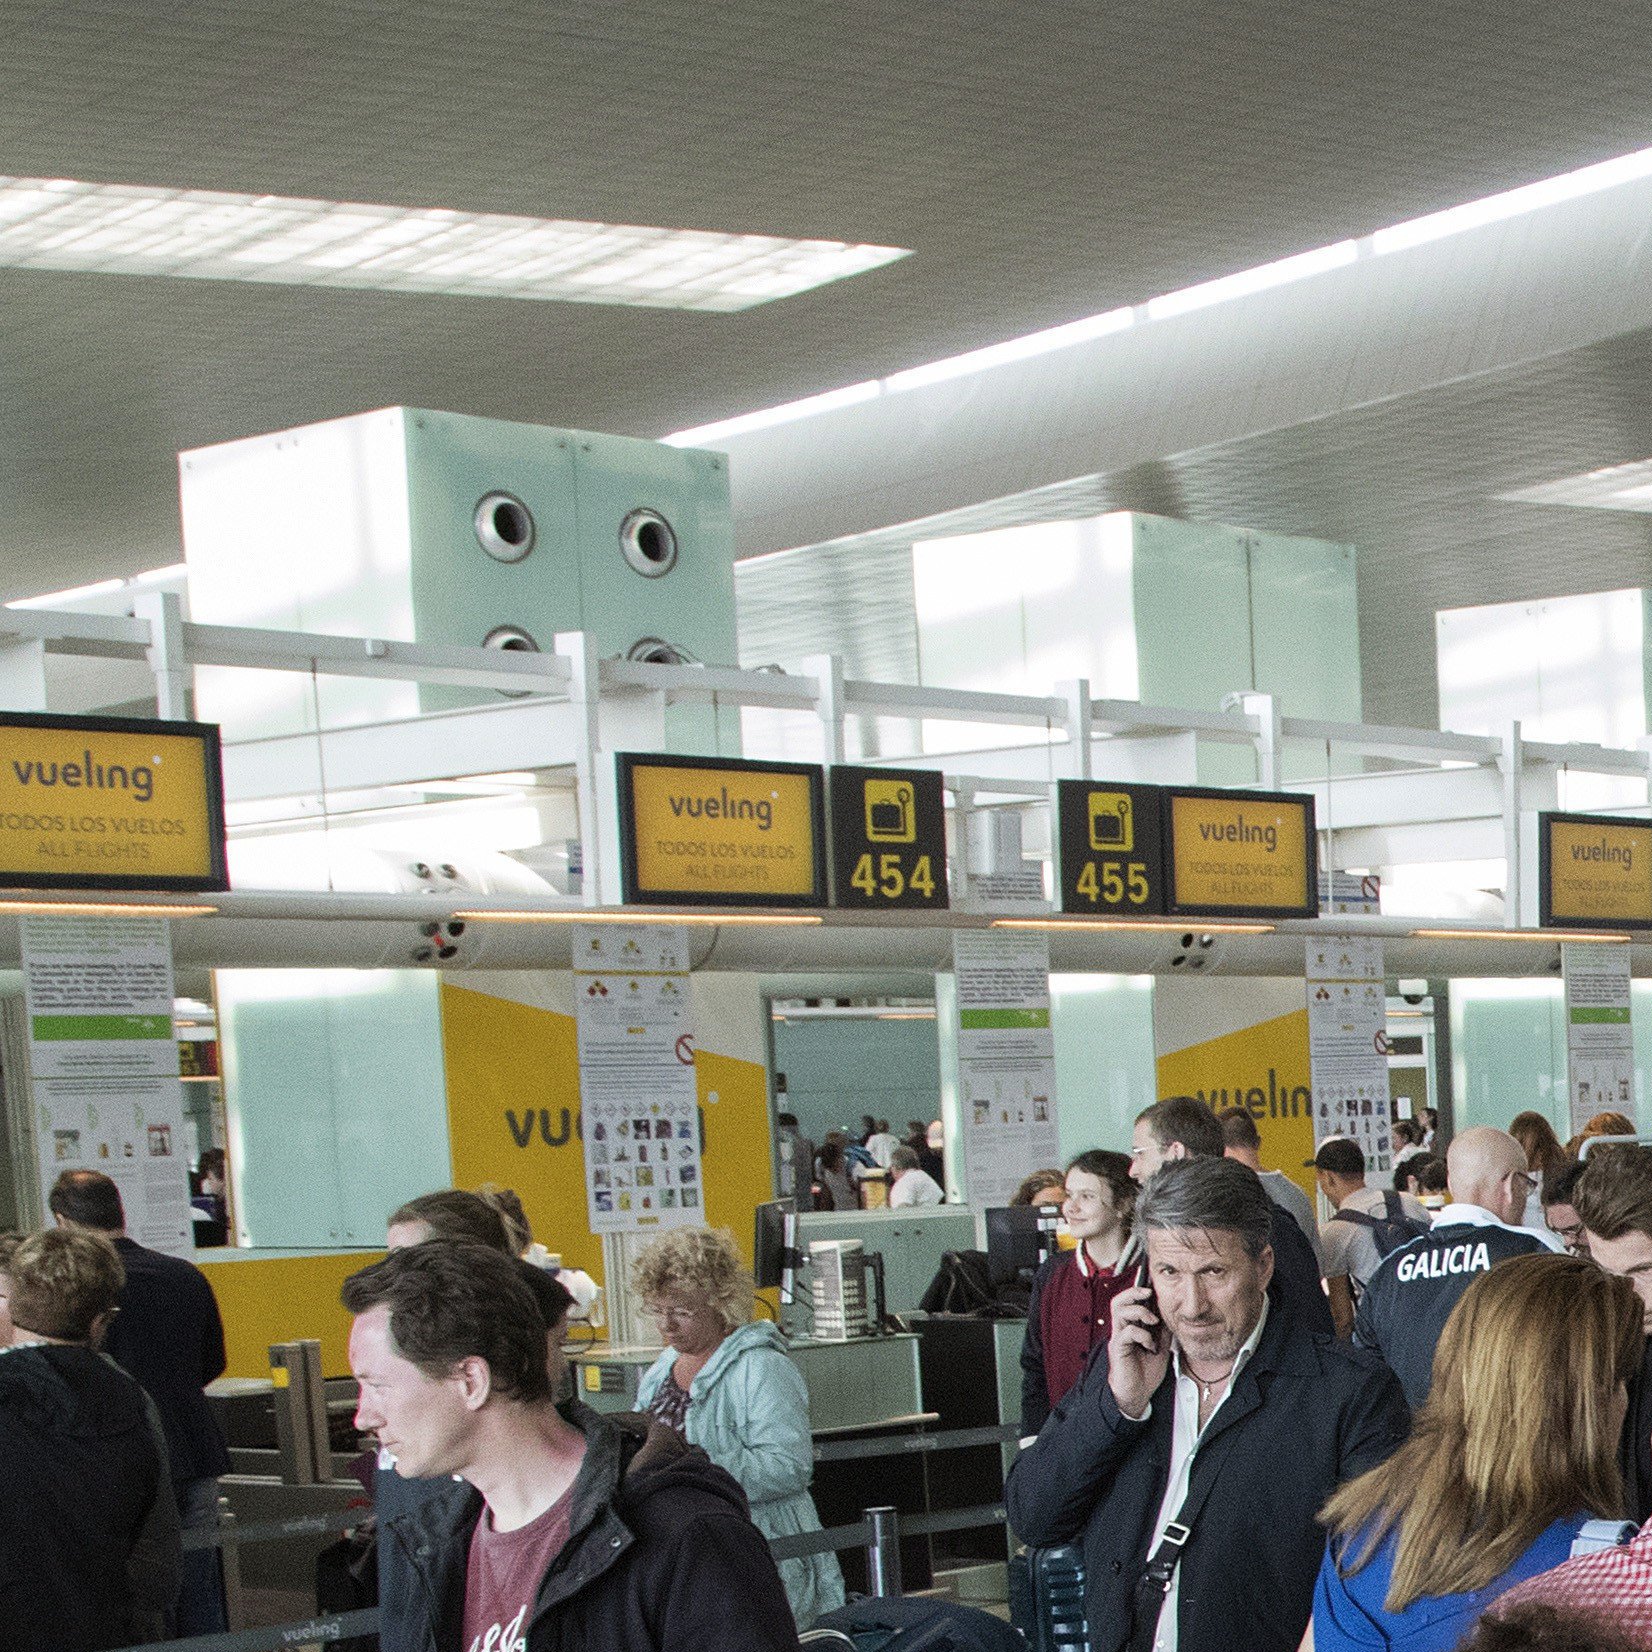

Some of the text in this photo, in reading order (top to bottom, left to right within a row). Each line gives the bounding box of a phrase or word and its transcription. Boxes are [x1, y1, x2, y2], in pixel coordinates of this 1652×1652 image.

[12, 749, 154, 803] vueling
[70, 815, 107, 834] LOS
[110, 817, 186, 836] VUELOS
[668, 786, 773, 832] vueling
[657, 840, 706, 858] TODOS
[1199, 814, 1278, 853] vueling
[1571, 838, 1632, 871] vueling
[851, 853, 935, 899] 454
[1076, 861, 1150, 905] 455
[1396, 1242, 1491, 1283] GALICIA
[281, 1616, 341, 1643] vueling
